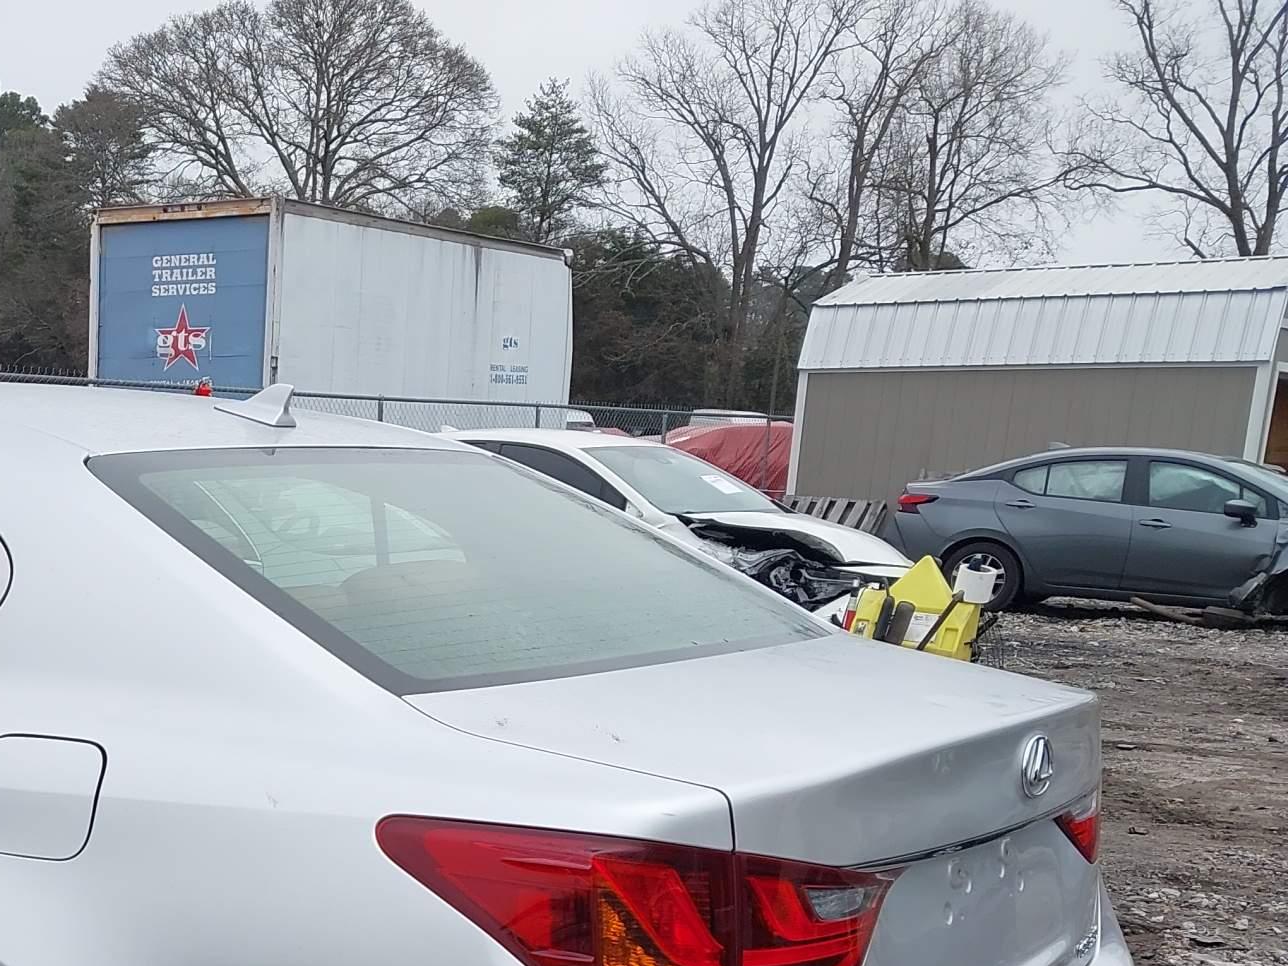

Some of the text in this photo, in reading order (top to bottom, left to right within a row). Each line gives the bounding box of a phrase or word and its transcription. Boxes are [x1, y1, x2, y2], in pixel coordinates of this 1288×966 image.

[152, 253, 217, 267] GENERAL
[152, 267, 216, 281] TRAILER
[151, 282, 216, 297] SERVICES
[156, 328, 206, 359] gts
[502, 337, 518, 350] gts
